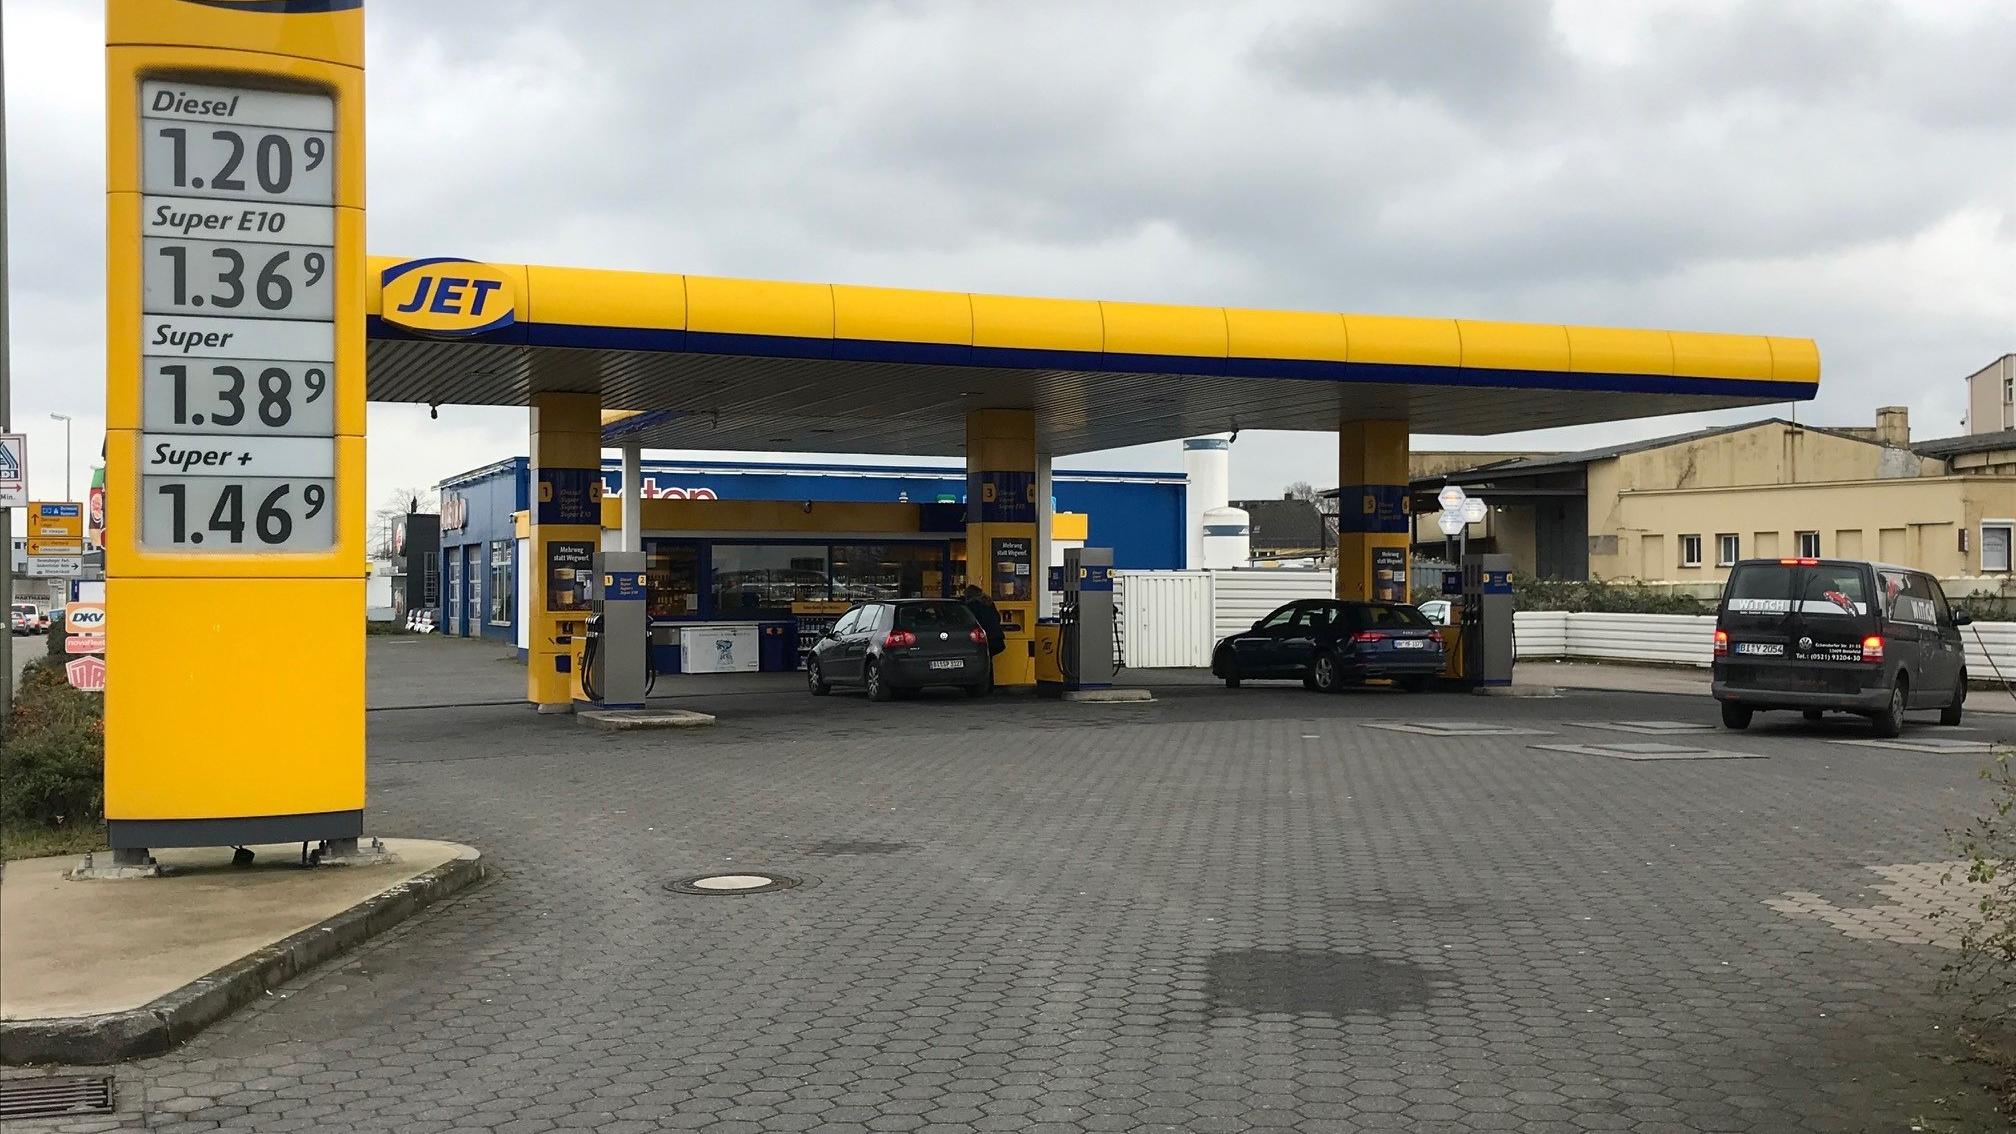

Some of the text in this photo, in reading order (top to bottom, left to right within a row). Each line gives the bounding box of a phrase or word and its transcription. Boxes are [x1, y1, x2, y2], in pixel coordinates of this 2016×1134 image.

[152, 90, 239, 117] Diesel
[152, 205, 286, 235] Super E10
[397, 276, 502, 316] JET
[152, 324, 233, 353] Super
[151, 443, 253, 472] Super +
[543, 487, 548, 497] 1
[592, 487, 599, 497] 2
[986, 488, 993, 498] 3
[560, 546, 584, 554] Mehrweg
[72, 612, 104, 622] DKV
[1741, 644, 1750, 652] BI
[1763, 645, 1783, 653] 2054
[1810, 653, 1830, 661] (0521)
